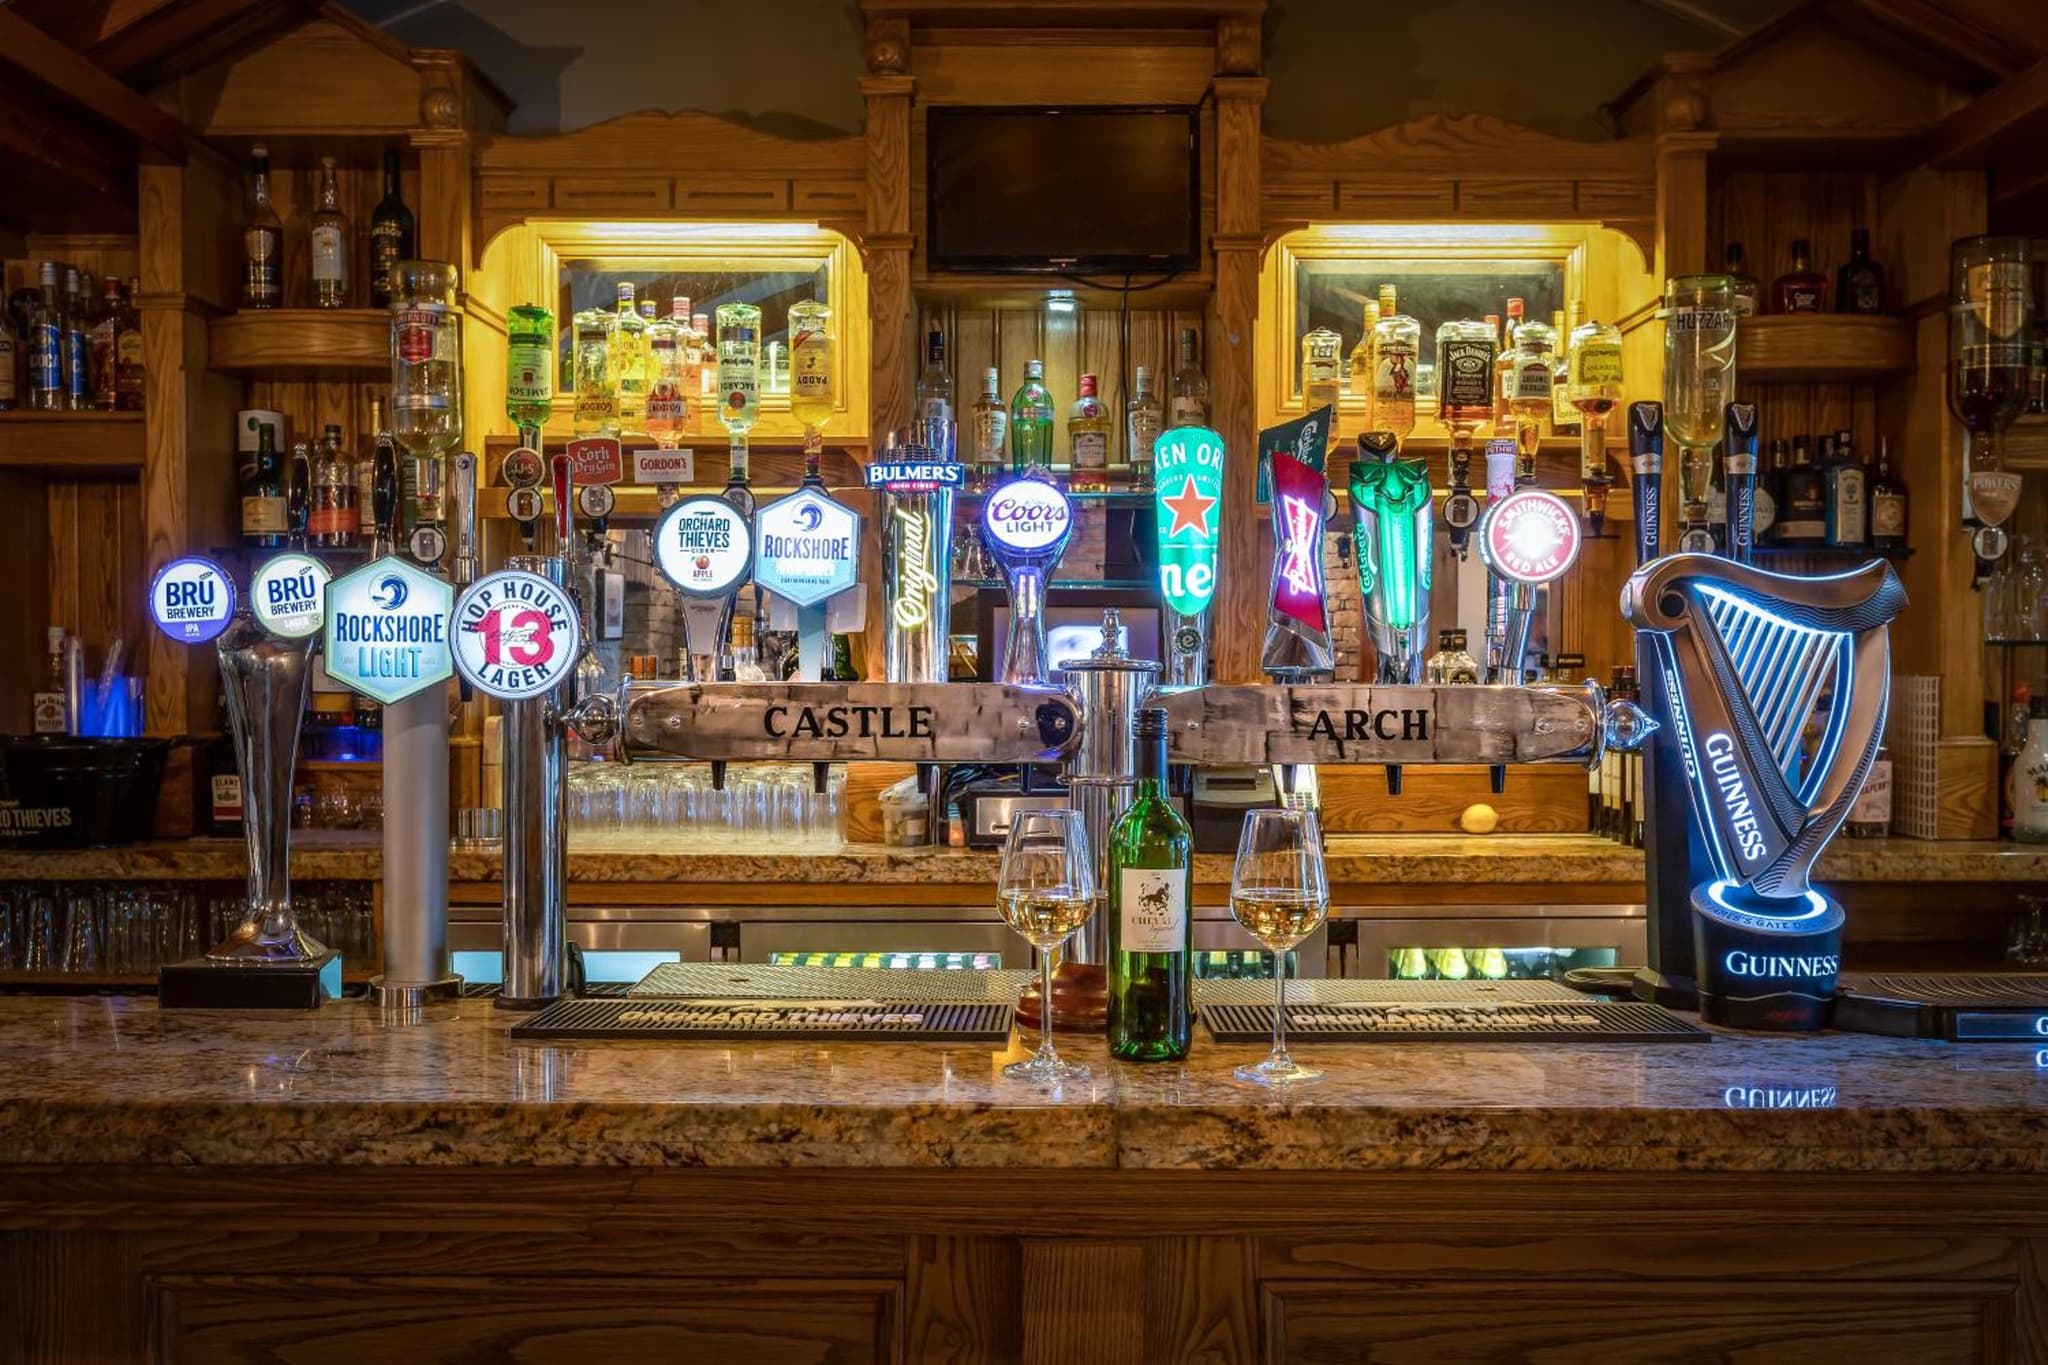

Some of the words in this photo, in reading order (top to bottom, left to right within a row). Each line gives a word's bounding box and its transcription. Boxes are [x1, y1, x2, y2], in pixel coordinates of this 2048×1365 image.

[797, 376, 827, 385] PADDY
[869, 466, 960, 482] BULMERS
[1974, 478, 2017, 489] POWERS
[992, 498, 1067, 522] Coors
[1645, 488, 1657, 546] GUINNESS
[1736, 488, 1750, 546] GUINNESS
[679, 518, 730, 532] ORCHARD
[1006, 520, 1054, 534] LIGHT
[679, 531, 730, 548] THIEVES
[764, 534, 849, 561] ROCKSHORE
[895, 508, 939, 629] Original
[1356, 522, 1375, 595] Carlsberg
[1504, 554, 1533, 573] RED
[1534, 555, 1559, 573] ALE
[167, 606, 215, 619] BREWERY
[270, 599, 318, 615] BREWERY
[461, 590, 492, 633] HOP
[503, 581, 568, 633] HOUSE
[184, 622, 200, 634] IPA
[336, 612, 444, 643] ROCKSHORE
[477, 609, 555, 666] 13
[358, 646, 424, 679] LIGHT
[478, 662, 551, 689] LAGER
[763, 706, 933, 739] CASTLE
[1308, 709, 1428, 742] ARCH
[1705, 732, 1767, 861] GUINNESS
[11, 807, 71, 828] THIEVES
[1756, 920, 1788, 929] GATE
[1725, 950, 1839, 977] GUINNESS
